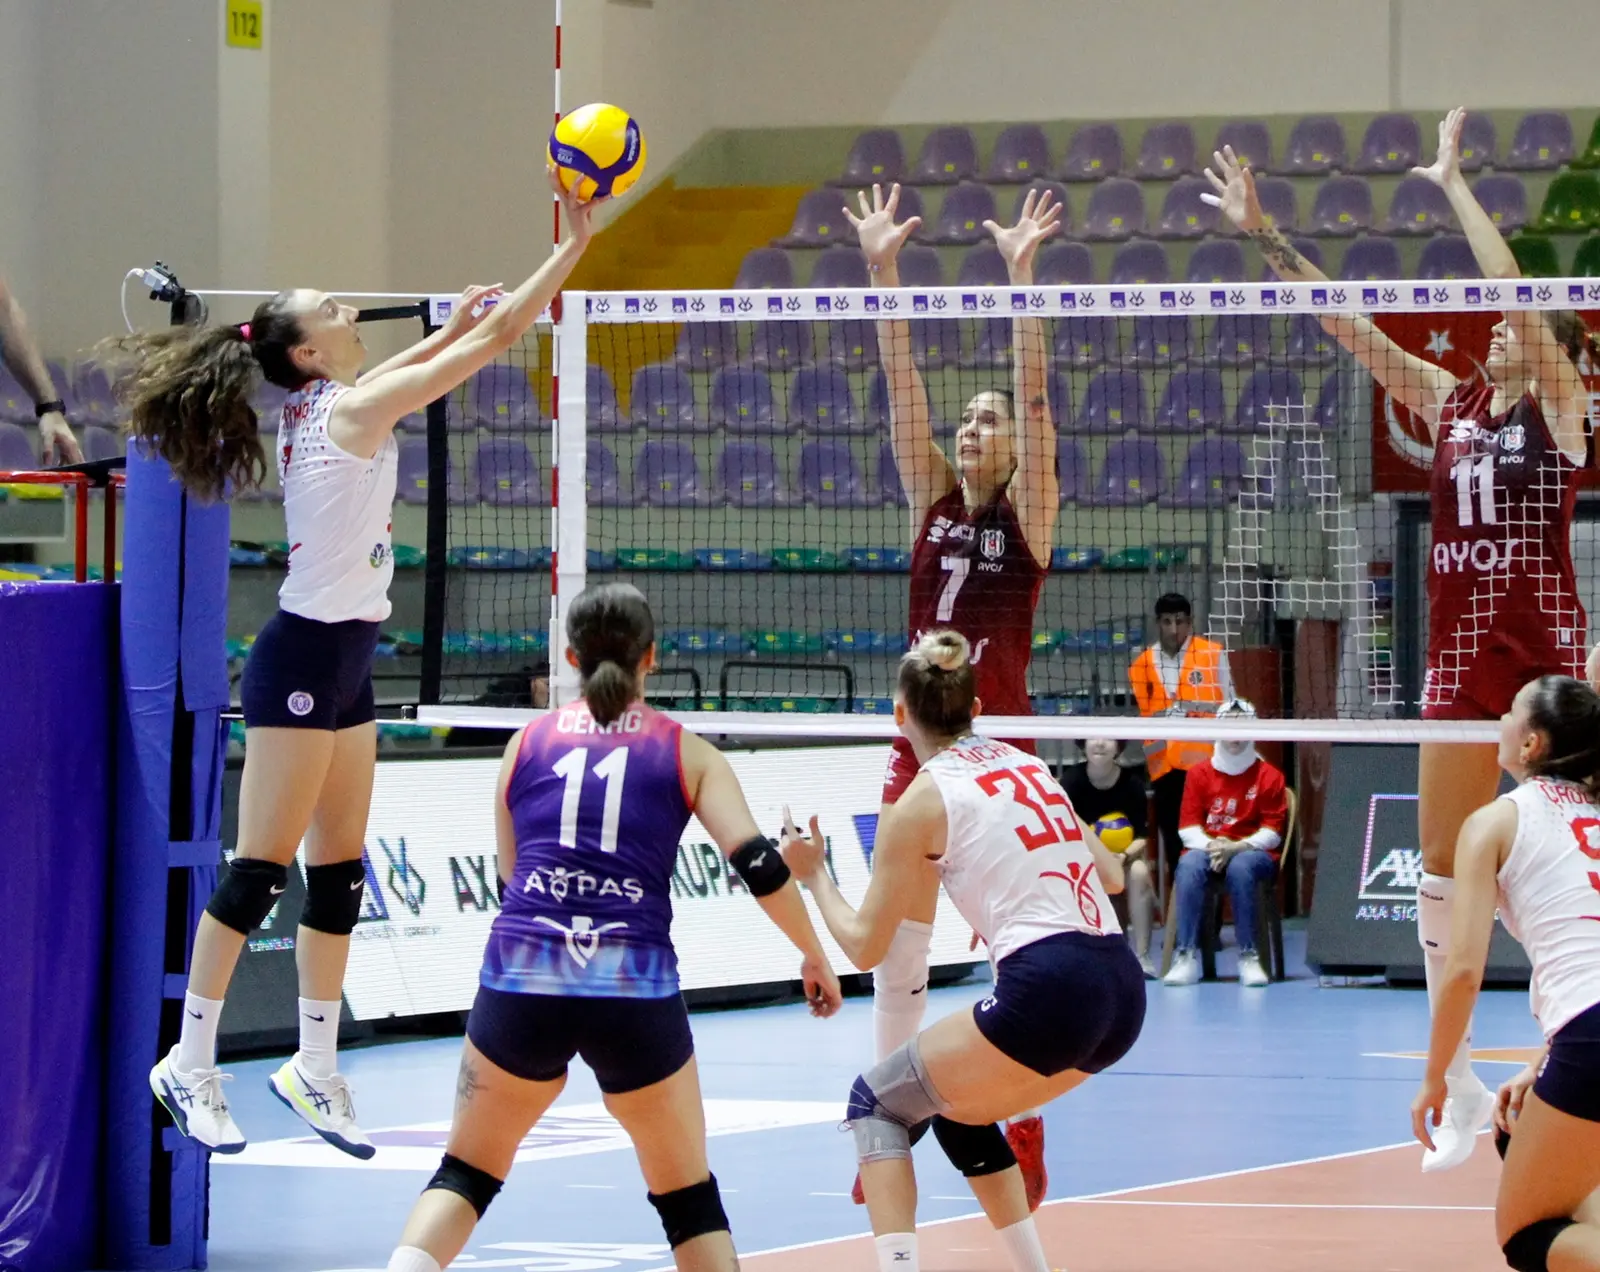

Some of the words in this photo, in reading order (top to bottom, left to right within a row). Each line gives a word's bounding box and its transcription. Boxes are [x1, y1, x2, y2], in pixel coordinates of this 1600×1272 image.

[232, 11, 258, 38] 112
[1450, 455, 1497, 526] 11
[936, 556, 971, 622] 7
[552, 746, 629, 853] 11
[975, 764, 1083, 852] 35
[448, 855, 502, 913] AX
[1366, 849, 1422, 887] AX
